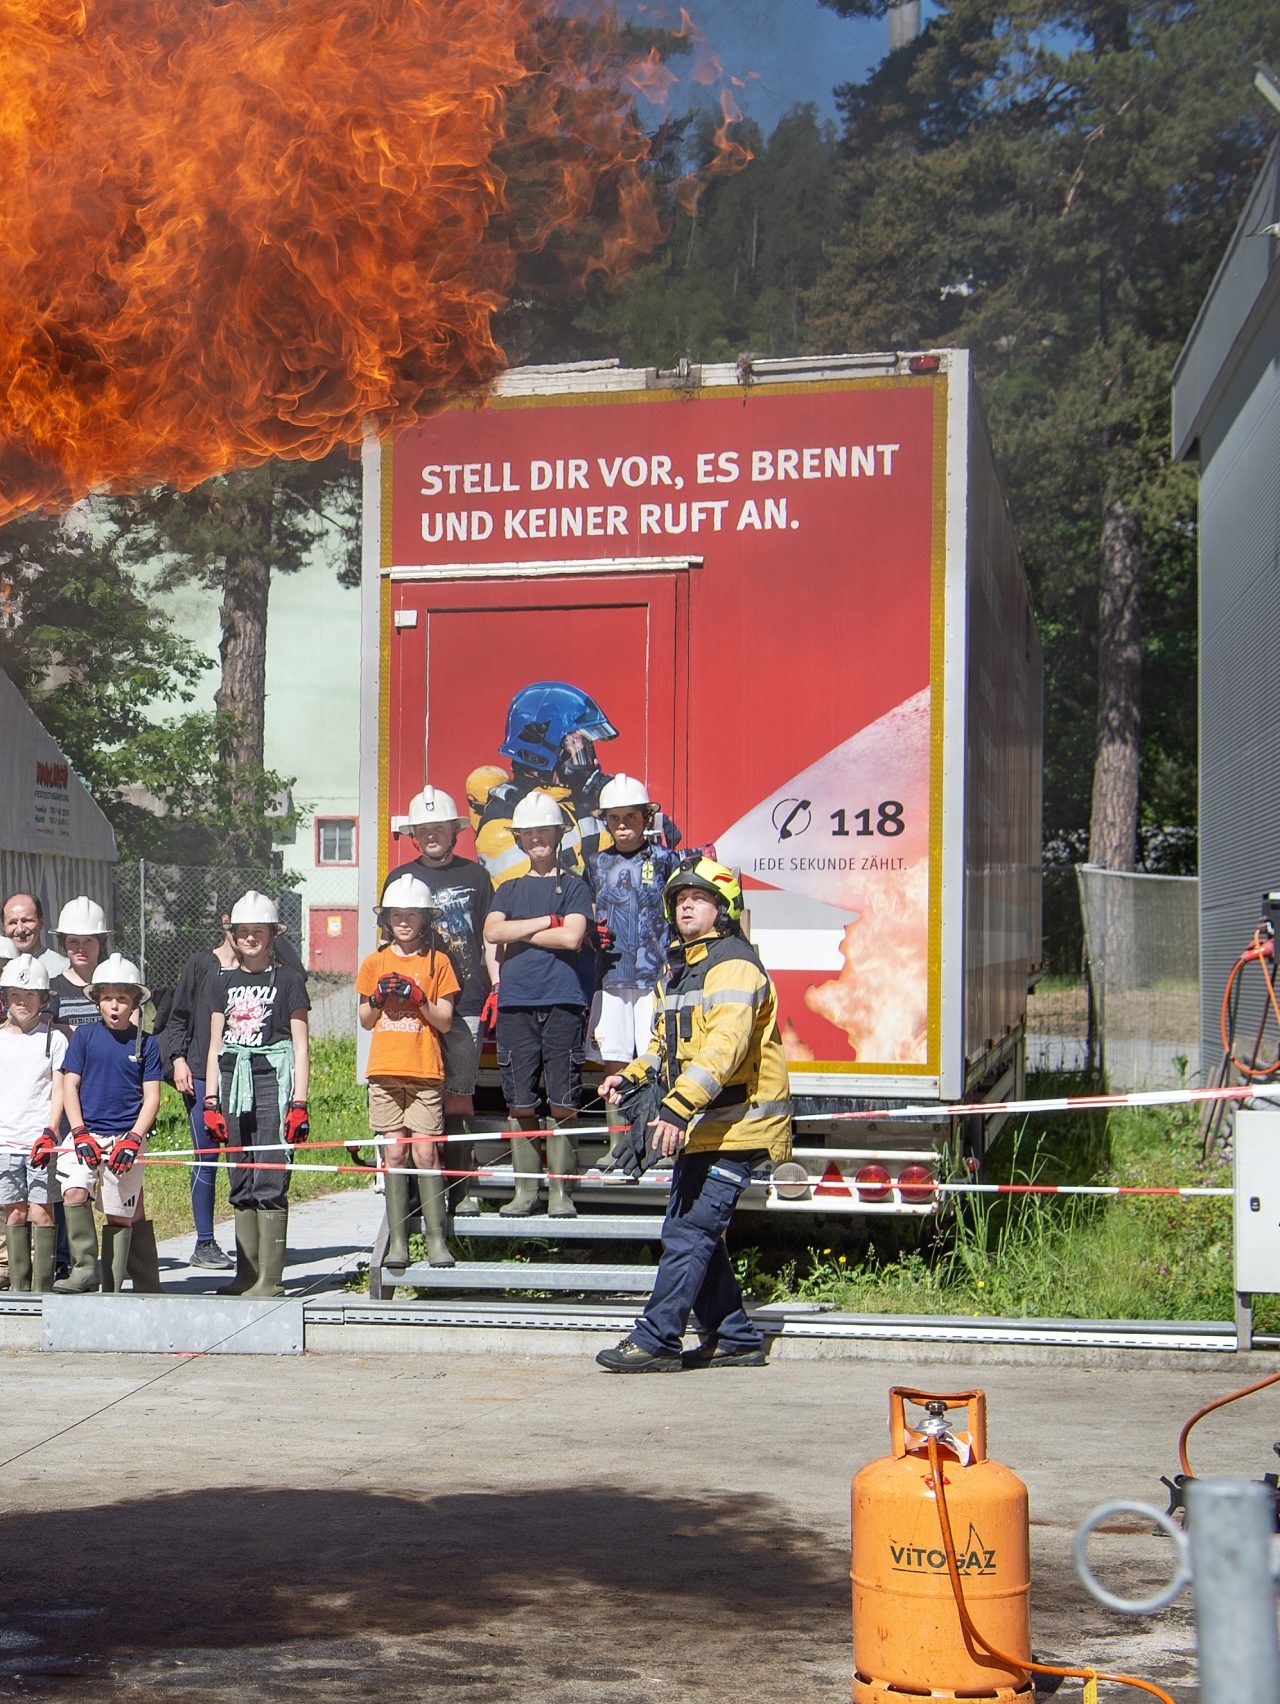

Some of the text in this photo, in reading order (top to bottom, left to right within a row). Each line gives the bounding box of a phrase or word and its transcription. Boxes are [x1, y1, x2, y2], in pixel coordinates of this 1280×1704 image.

[420, 444, 900, 496] STELL DIR VOR, ES BRENNT
[421, 497, 800, 543] UND KEINER RUFT AN.
[830, 800, 905, 837] 118
[753, 854, 907, 872] JEDE SEKUNDE ZÄHLT.
